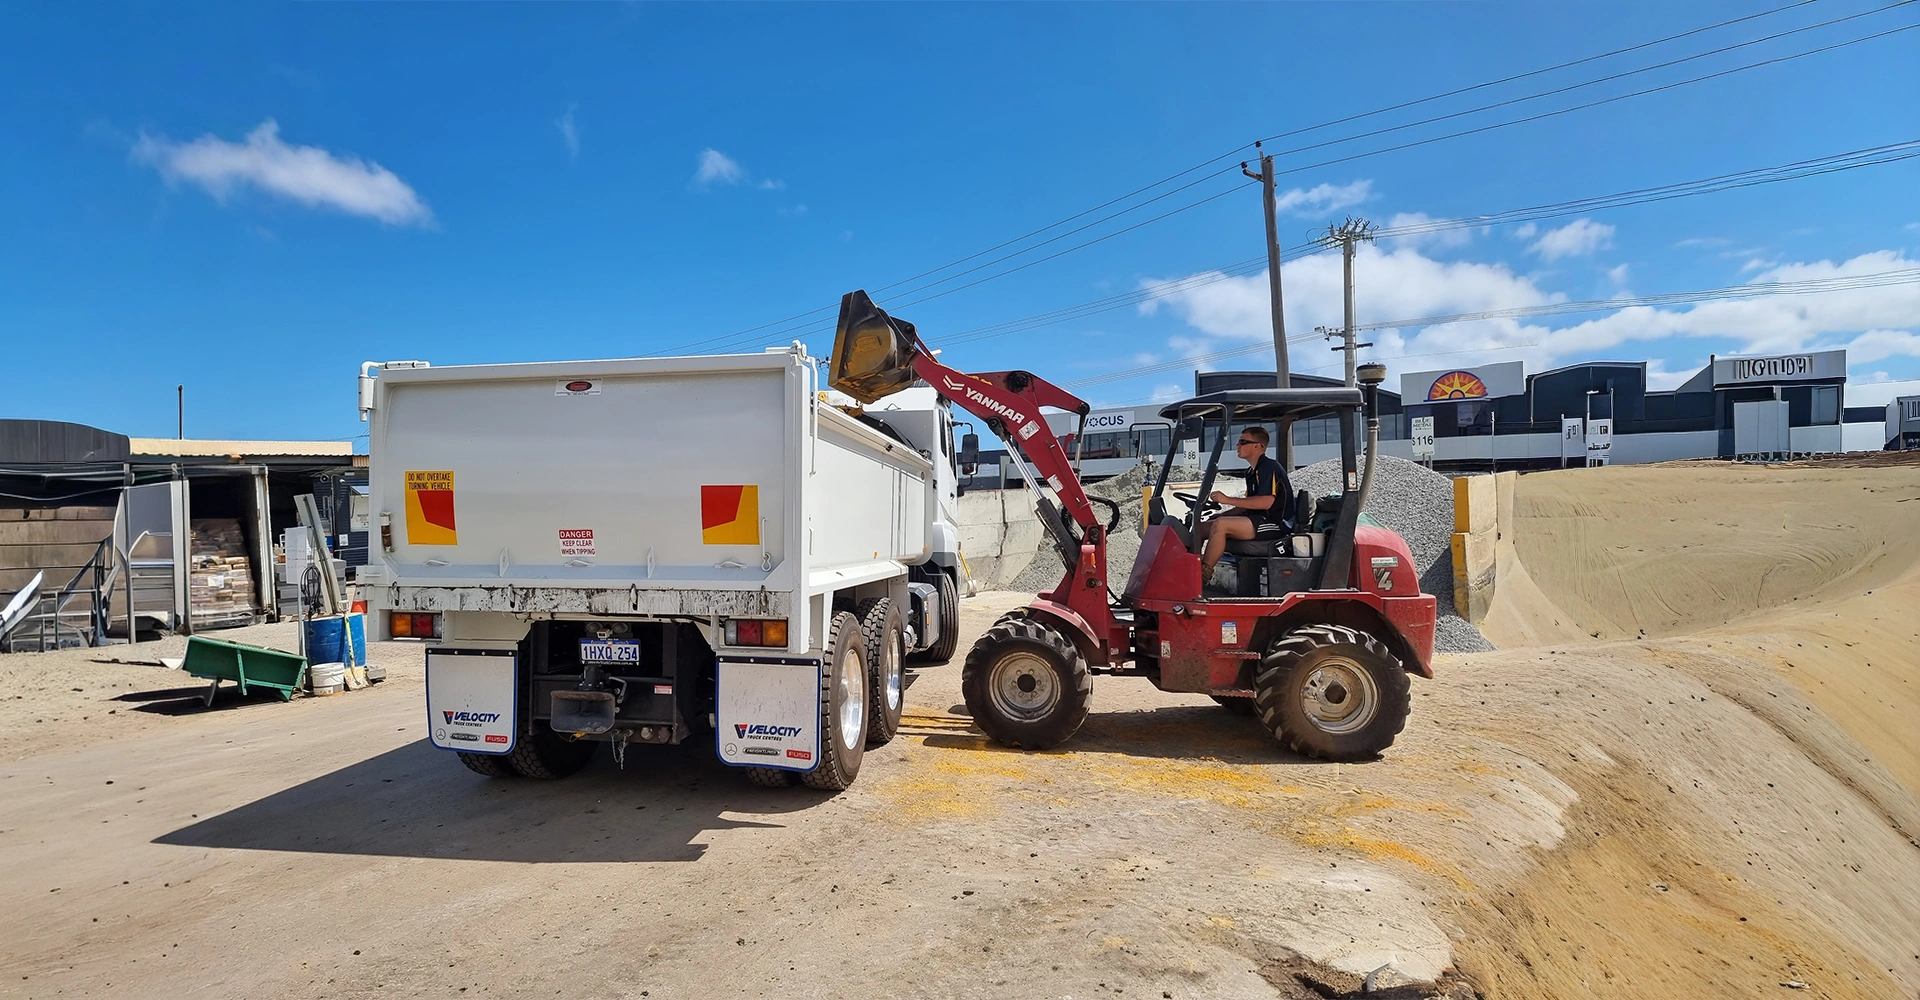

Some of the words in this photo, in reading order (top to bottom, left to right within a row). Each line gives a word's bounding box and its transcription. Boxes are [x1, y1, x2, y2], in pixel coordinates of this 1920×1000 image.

[965, 387, 1025, 424] YANMAR
[1411, 435, 1434, 446] $116
[408, 473, 415, 481] DO
[416, 473, 425, 481] NOT
[427, 472, 451, 481] OVERTAKE
[408, 482, 428, 490] TURNING
[431, 482, 451, 490] VEHICLE
[454, 711, 501, 723] VELOCITY
[748, 724, 802, 737] VELOCITY
